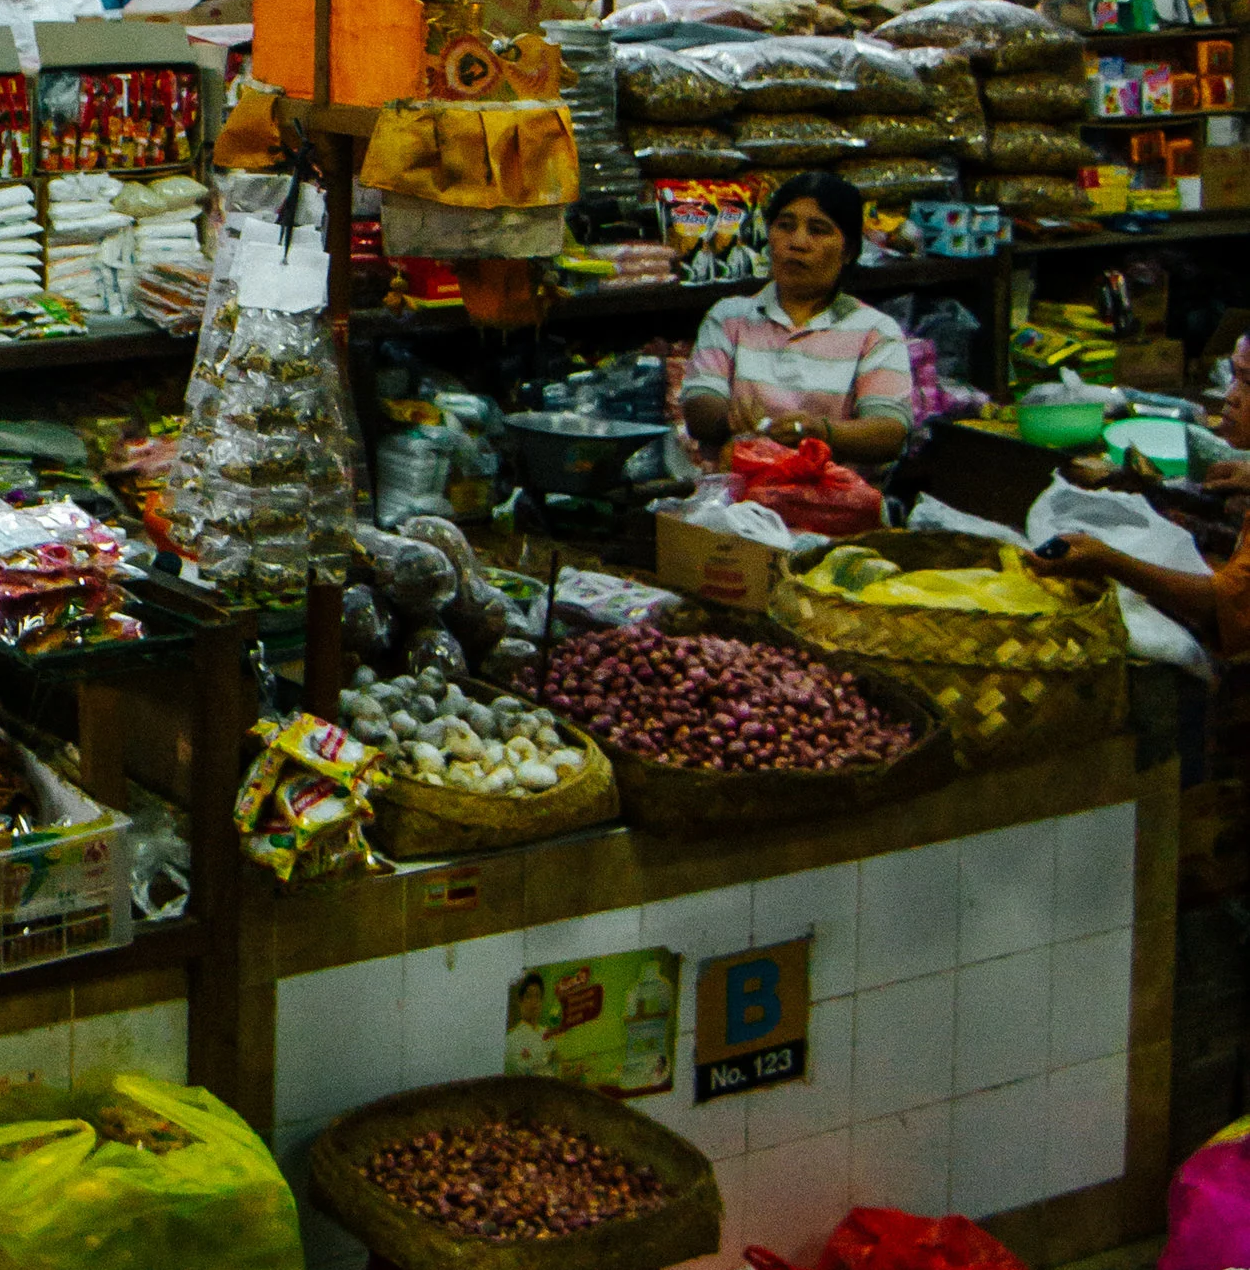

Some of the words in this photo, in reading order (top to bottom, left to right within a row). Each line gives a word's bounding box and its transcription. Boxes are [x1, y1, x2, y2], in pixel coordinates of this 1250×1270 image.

[726, 958, 782, 1045] B
[710, 1065, 746, 1091] No.
[753, 1048, 793, 1077] 123
